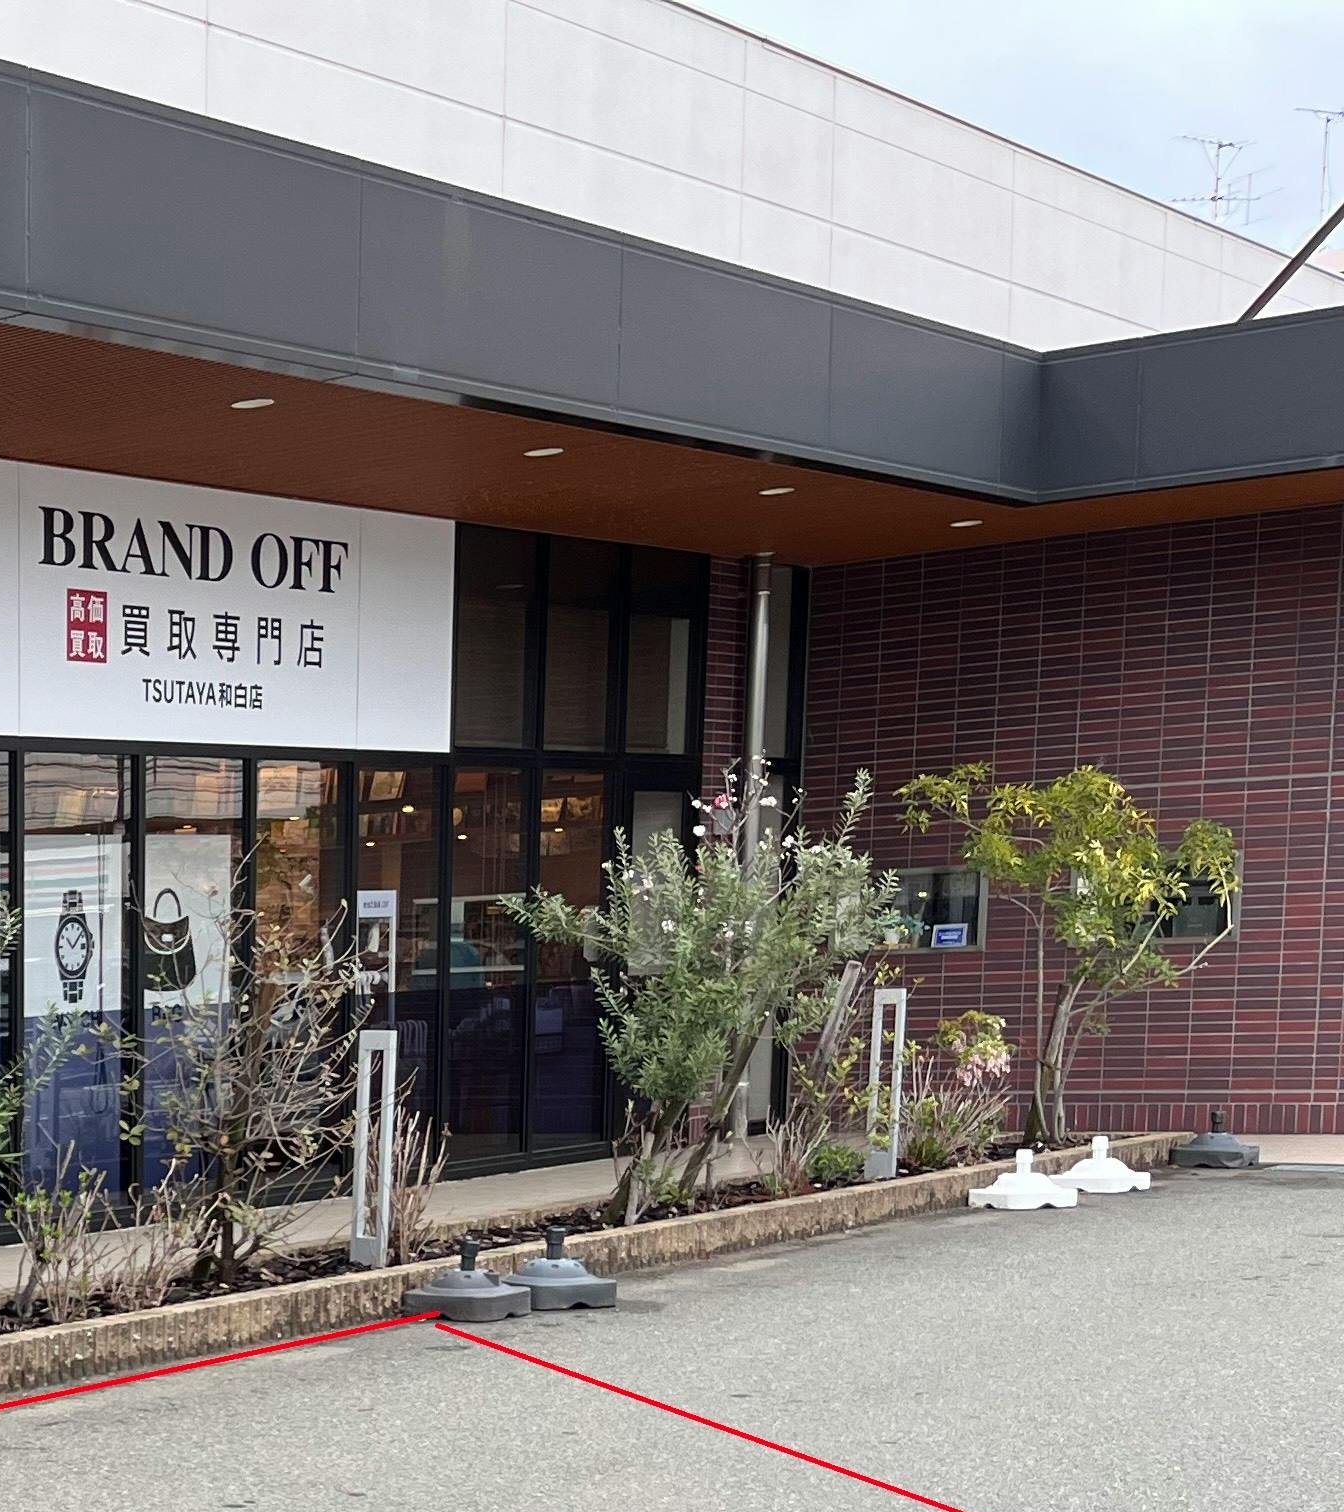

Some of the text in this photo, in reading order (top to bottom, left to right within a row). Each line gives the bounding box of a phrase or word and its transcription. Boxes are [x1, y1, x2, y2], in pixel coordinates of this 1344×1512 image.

[37, 505, 349, 594] BRAND OFF
[68, 592, 105, 623] 高価
[68, 629, 105, 659] 買取
[120, 603, 325, 669] 買取専門店
[142, 677, 264, 710] TSUTAYA和白店
